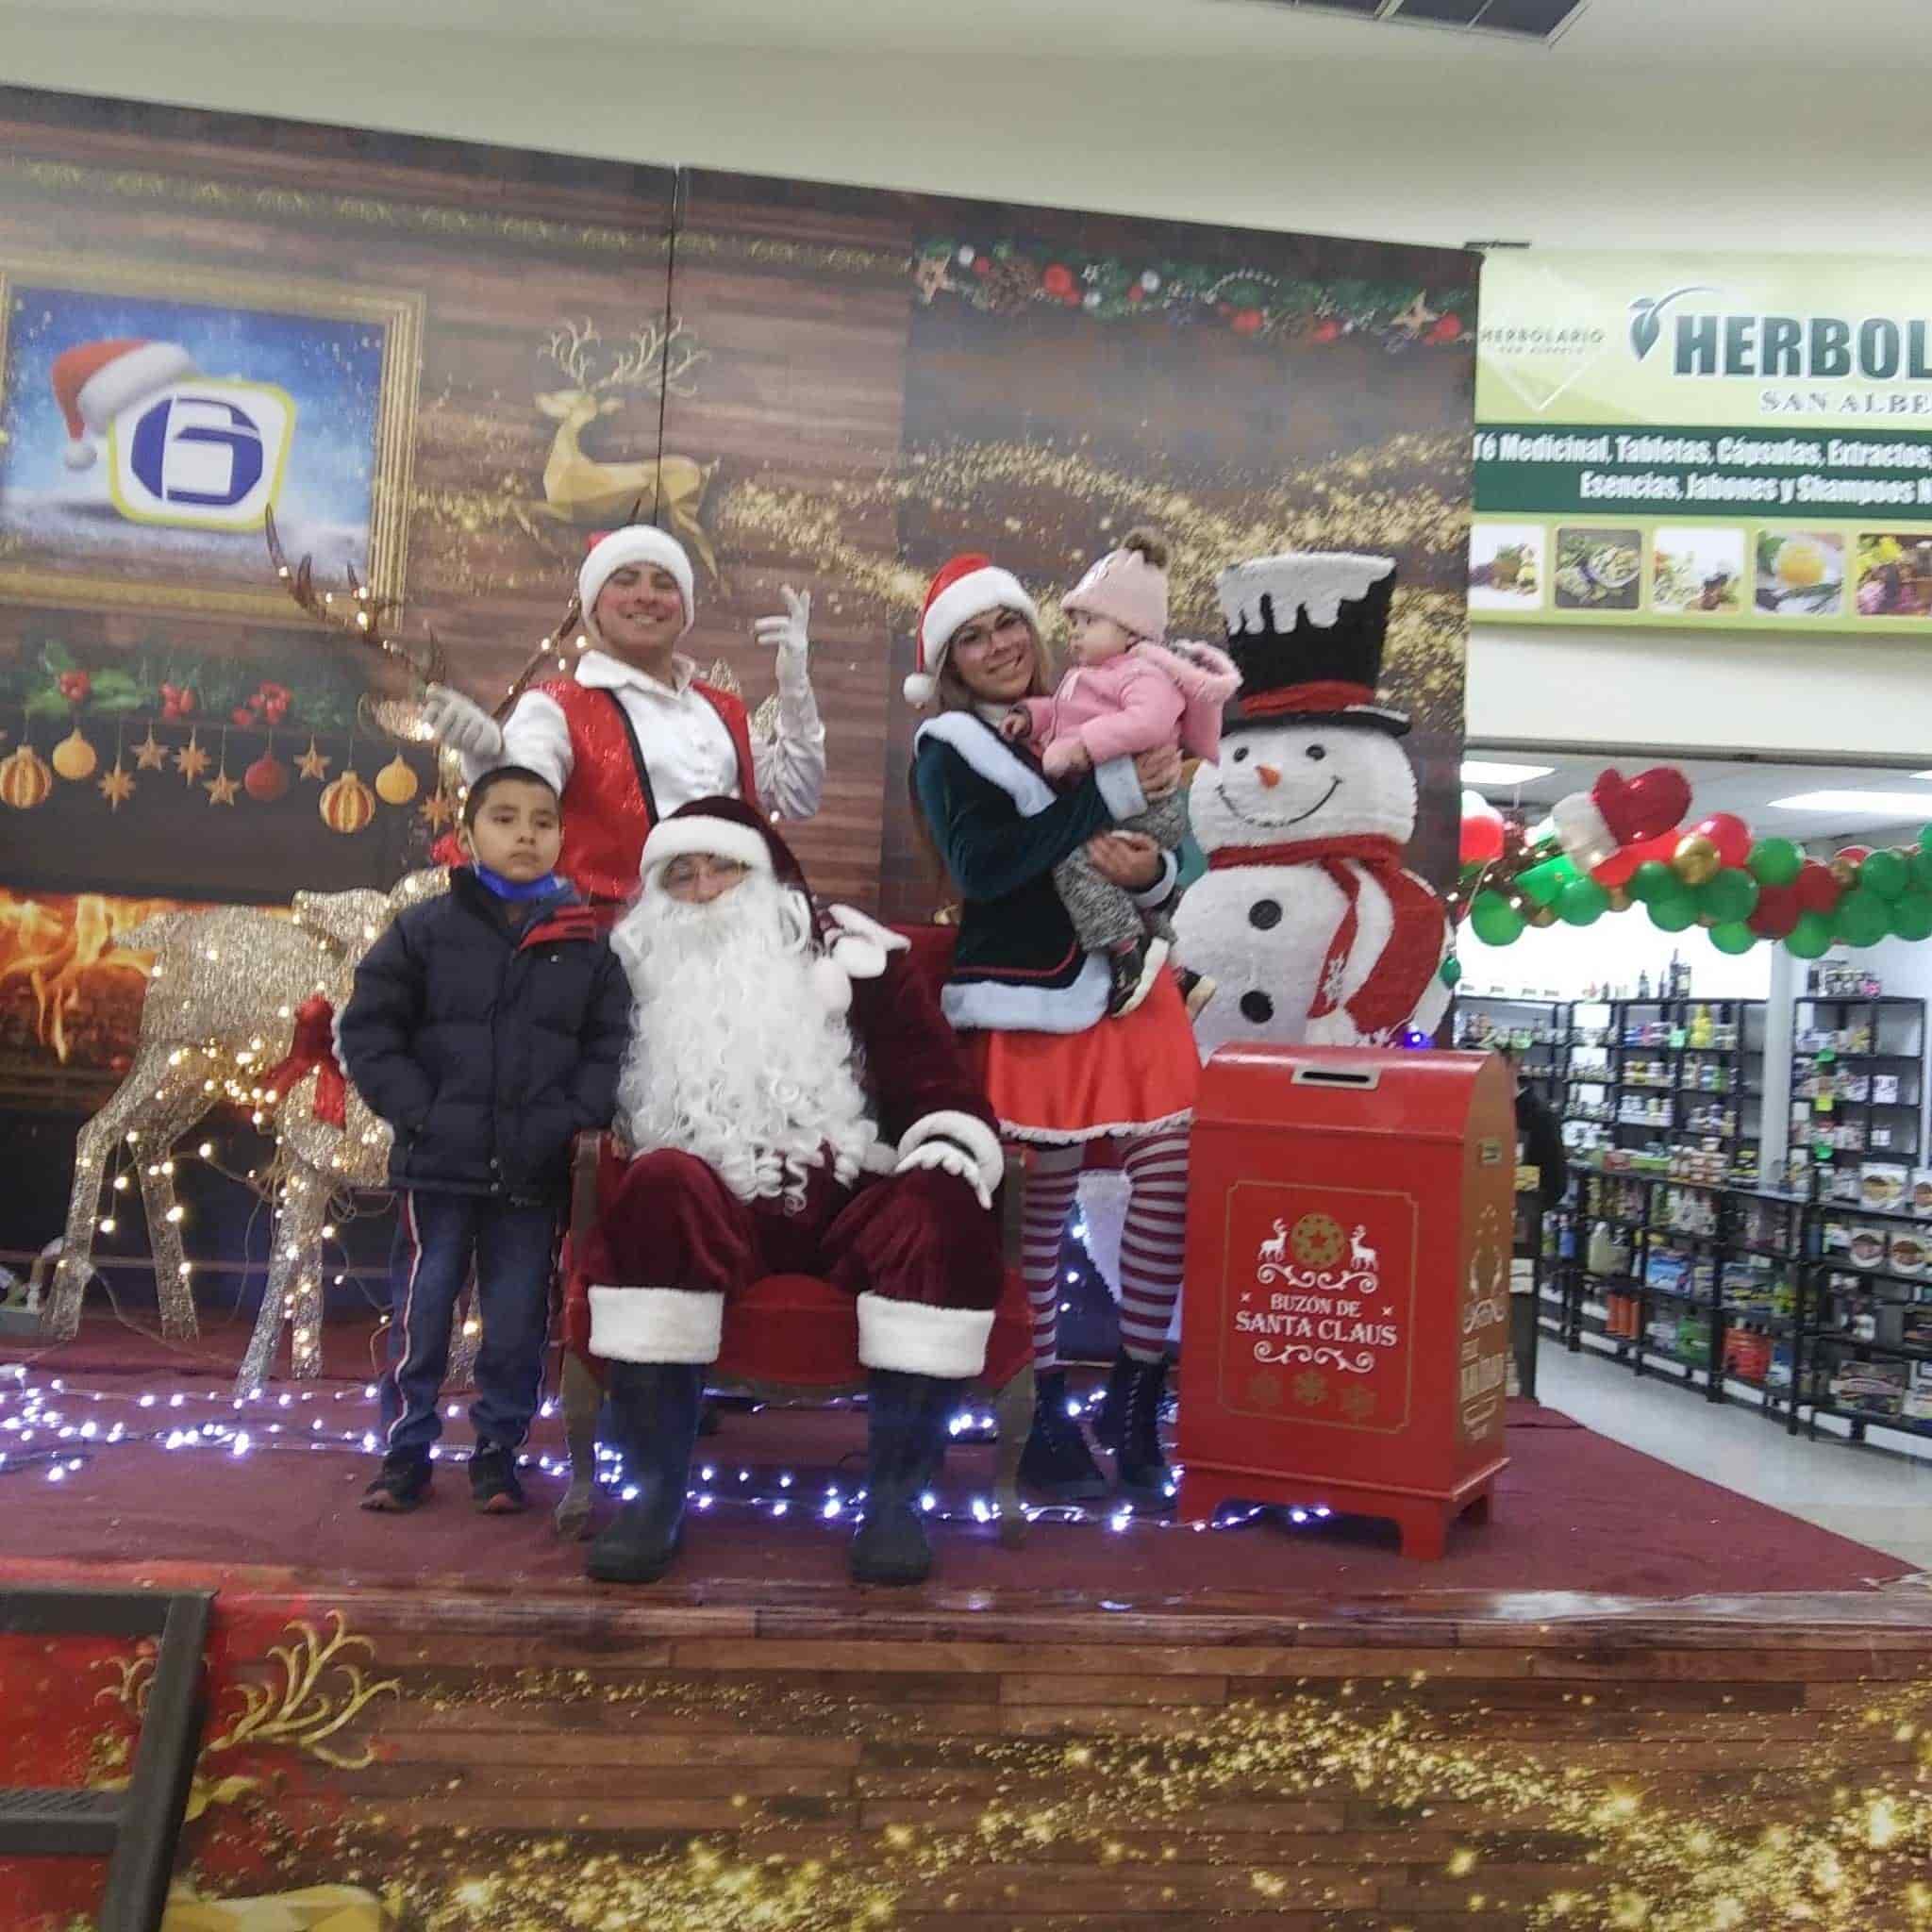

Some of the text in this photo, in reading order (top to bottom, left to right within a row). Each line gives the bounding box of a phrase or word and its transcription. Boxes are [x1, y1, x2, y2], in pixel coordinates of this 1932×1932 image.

[1674, 314, 1932, 379] HERBOL
[1760, 390, 1932, 416] SAN ALBE
[1499, 433, 1614, 464] Medicinal,
[1615, 435, 1714, 466] Tabletas,
[1716, 436, 1826, 468] Cápsulas,
[1579, 470, 1684, 501] Esencias,
[1686, 471, 1779, 502] Jabones
[1780, 477, 1796, 505] y
[1795, 474, 1917, 506] Shampoos
[1336, 1299, 1363, 1318] DE
[1235, 1310, 1397, 1347] SANTA CLAUS
